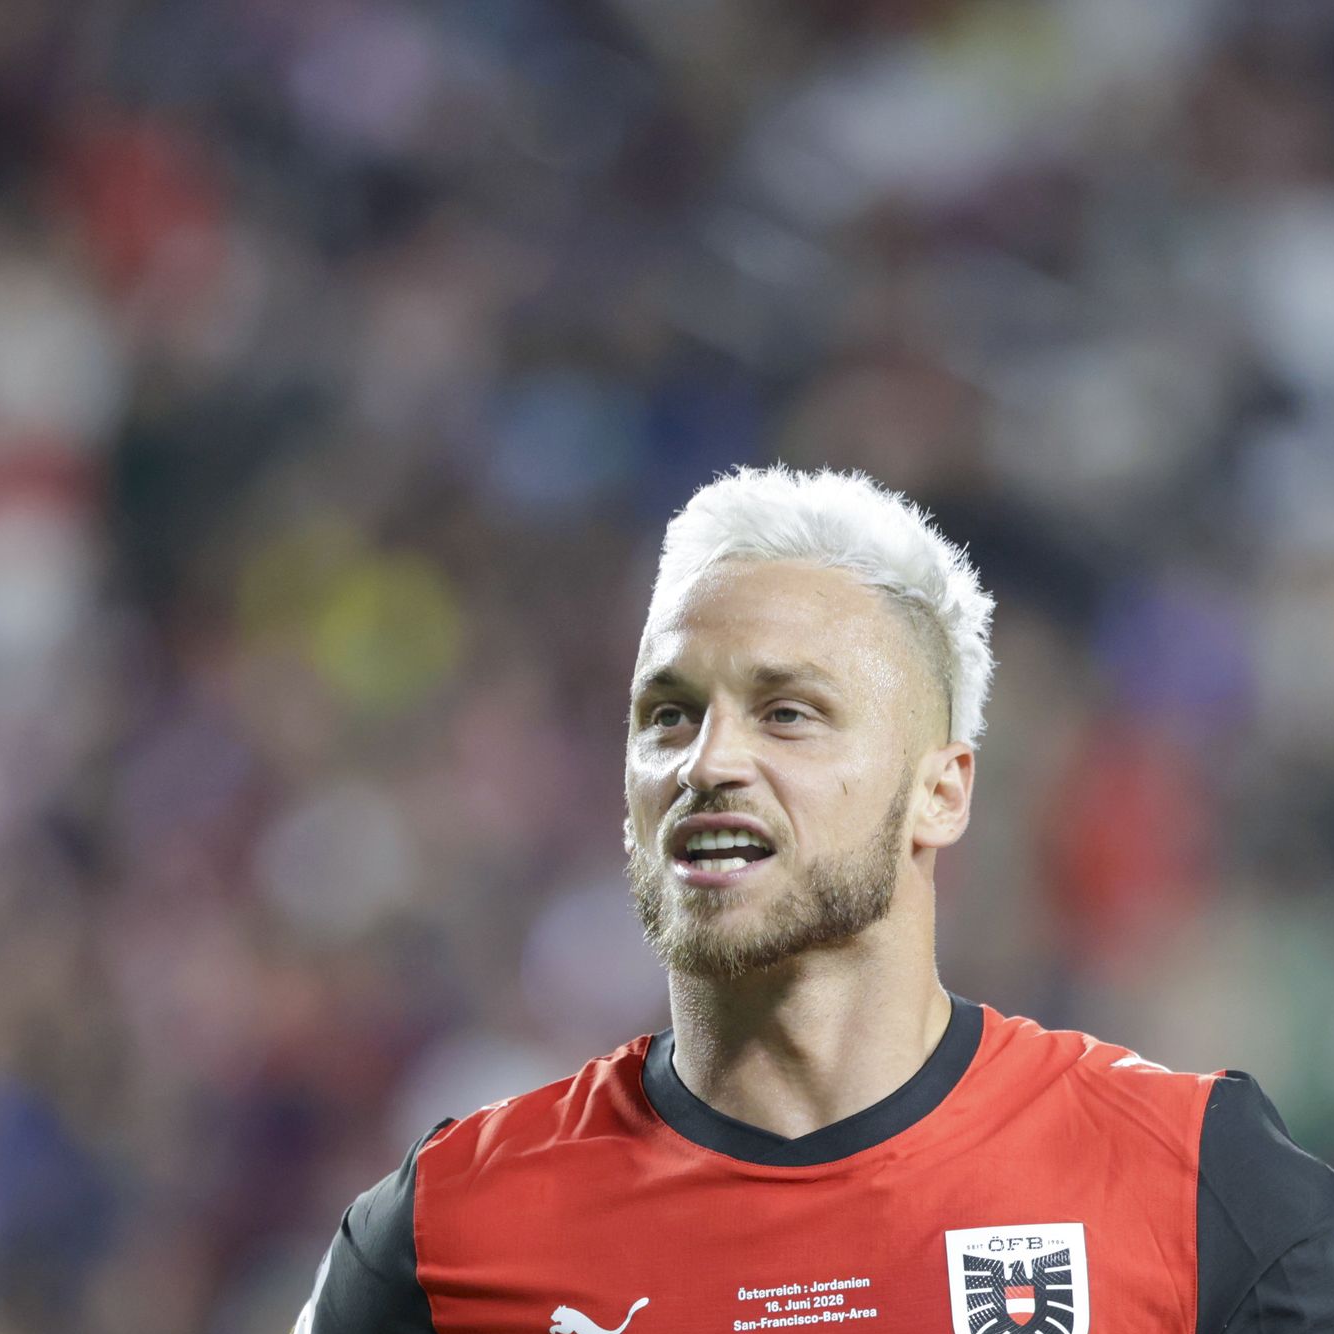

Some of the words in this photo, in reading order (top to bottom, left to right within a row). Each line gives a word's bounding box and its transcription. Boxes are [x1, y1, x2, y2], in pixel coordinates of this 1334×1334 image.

[988, 1236, 1043, 1252] ÖFB
[737, 1284, 802, 1301] Österreich
[810, 1277, 870, 1293] Jordanien
[765, 1301, 783, 1313] 16.
[785, 1298, 811, 1311] Juni
[813, 1294, 845, 1308] 2026
[733, 1307, 878, 1332] San-Francisco-Bay-Area
